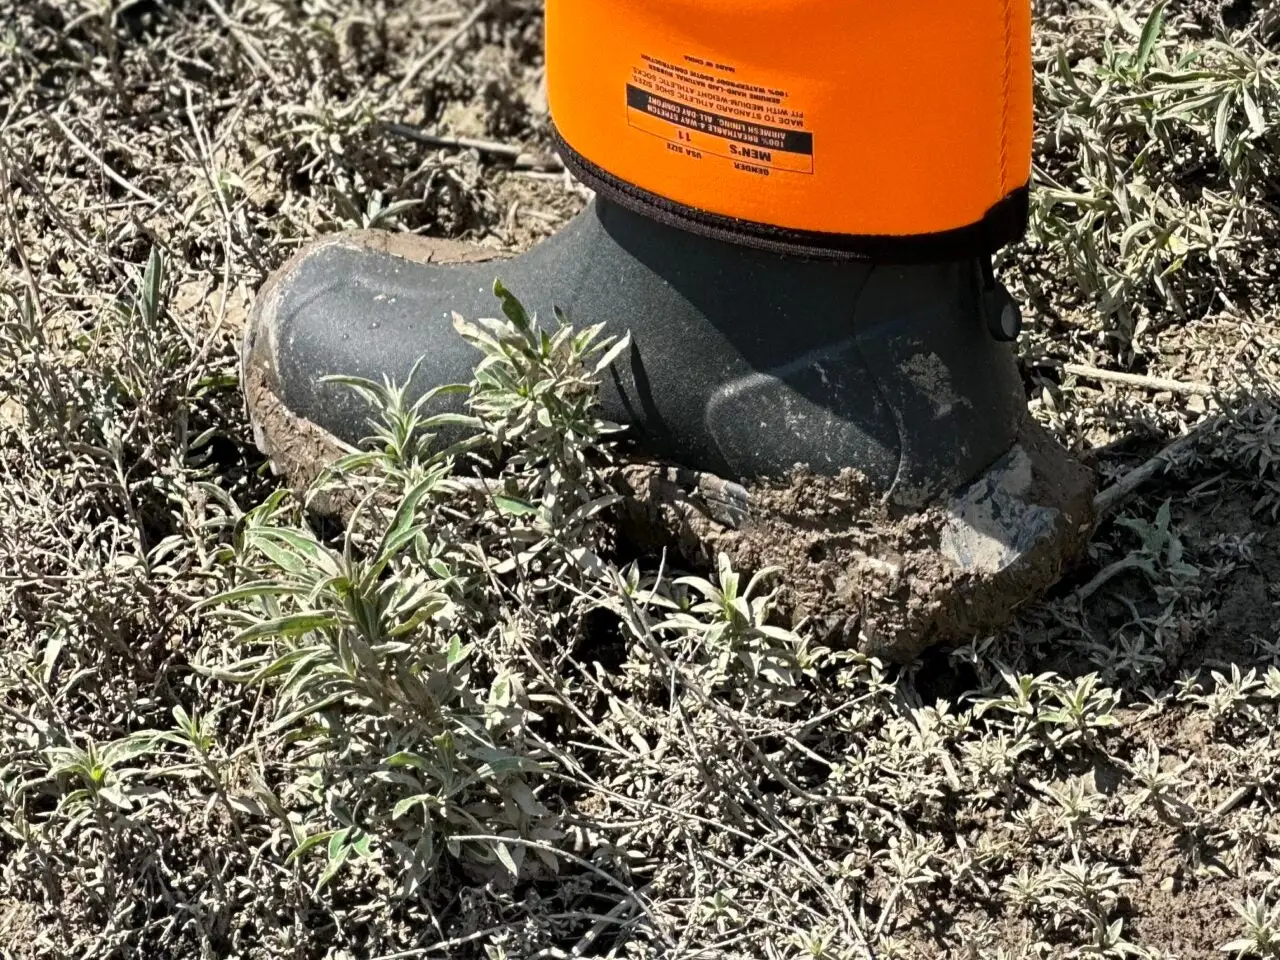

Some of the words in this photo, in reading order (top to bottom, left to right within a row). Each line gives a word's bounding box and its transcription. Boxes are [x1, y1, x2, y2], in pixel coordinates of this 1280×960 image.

[683, 55, 704, 65] CHINA
[715, 64, 735, 73] MADE
[659, 77, 694, 94] ATHLETIC
[676, 74, 706, 87] NATURAL
[717, 79, 766, 93] WATERPROOF
[655, 84, 674, 96] SHOE
[768, 89, 788, 97] 100%
[677, 92, 714, 108] ATHLETIC
[697, 91, 764, 112] MEDIUM-WEIGHT
[647, 105, 679, 121] STRETCH
[716, 104, 762, 120] STANDARD
[766, 107, 788, 116] WITH
[764, 115, 776, 123] TO
[779, 117, 804, 127] MADE
[678, 130, 691, 142] 11
[708, 125, 759, 143] BREATHABLE
[748, 126, 786, 140] AIRMESH
[667, 143, 683, 154] SIZE
[760, 138, 784, 148] 100%
[686, 149, 702, 160] USA
[729, 144, 771, 162] MEN'S
[734, 162, 769, 176] GENDER
